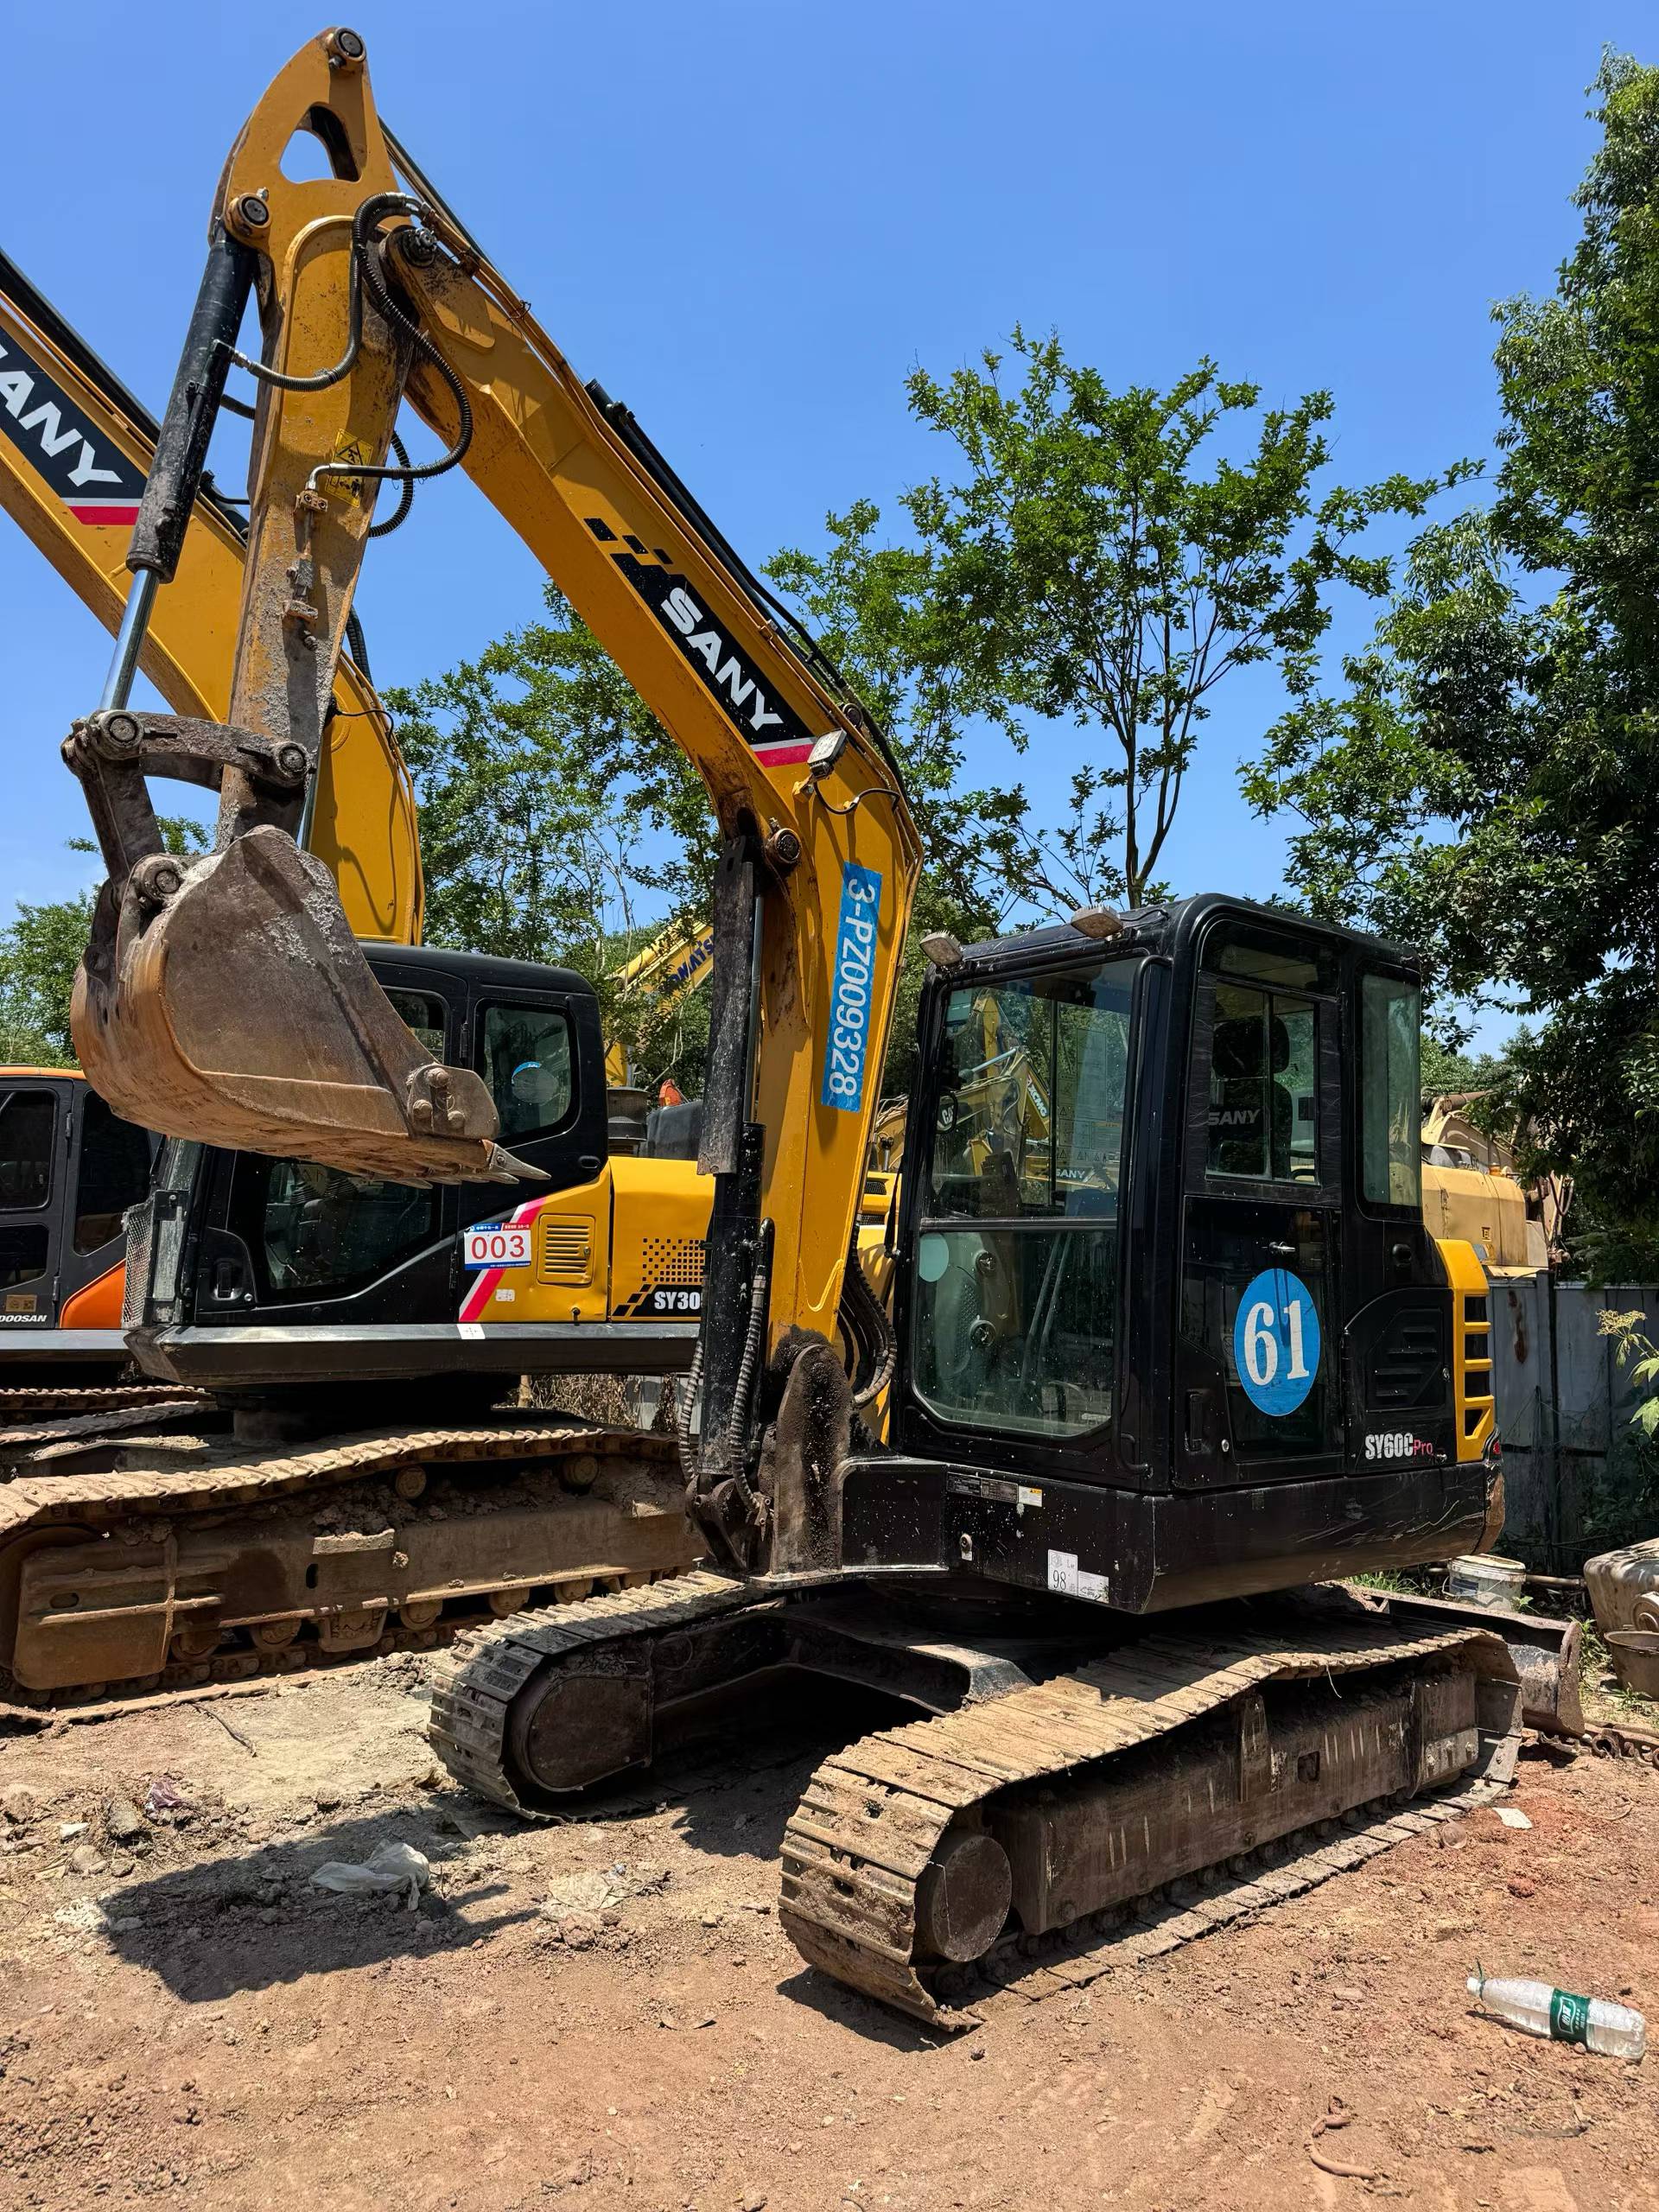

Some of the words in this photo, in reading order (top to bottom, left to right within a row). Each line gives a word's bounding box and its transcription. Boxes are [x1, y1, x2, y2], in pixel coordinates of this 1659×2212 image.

[0, 345, 124, 487] ANY
[661, 588, 784, 731] SANY
[829, 877, 876, 1096] 3-PZ009328
[1208, 1109, 1261, 1125] SANY
[471, 1235, 524, 1260] 003
[654, 1291, 703, 1310] SY30
[1244, 1300, 1310, 1386] 61
[1052, 1569, 1067, 1591] 98
